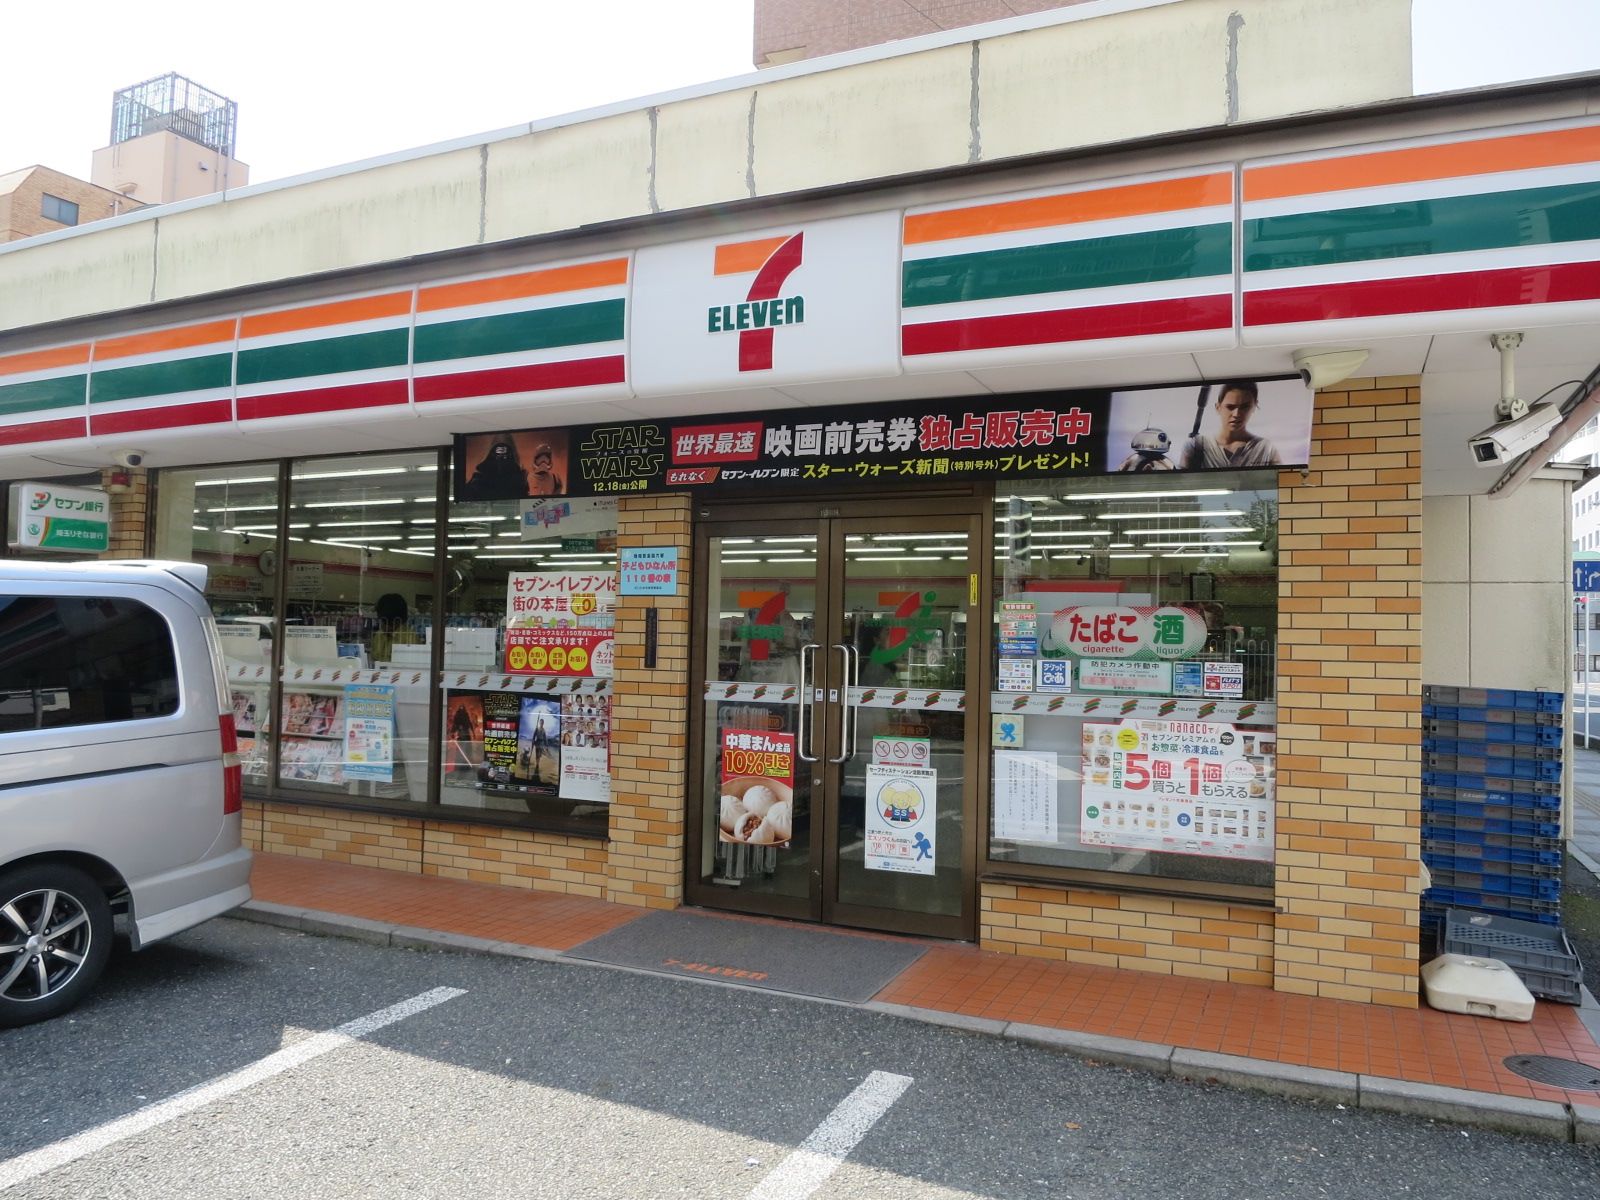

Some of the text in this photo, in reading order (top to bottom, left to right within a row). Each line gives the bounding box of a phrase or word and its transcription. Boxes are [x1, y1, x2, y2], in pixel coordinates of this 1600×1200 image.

[581, 425, 665, 451] STAR
[676, 432, 757, 457] 世界最速
[580, 454, 664, 479] WARS
[670, 470, 706, 483] もれなく
[54, 498, 105, 513] セブン銀行
[513, 595, 568, 612] 街の本屋
[1069, 613, 1139, 644] たばこ
[1152, 614, 1185, 644] 酒
[1082, 645, 1125, 654] cigarette
[1156, 646, 1185, 656] liquor
[1091, 661, 1160, 669] 防犯カメラ作動中
[1151, 734, 1216, 744] セブンプレミアムの
[725, 750, 791, 776] 10%引き
[1152, 780, 1248, 799] 買うと もらえる
